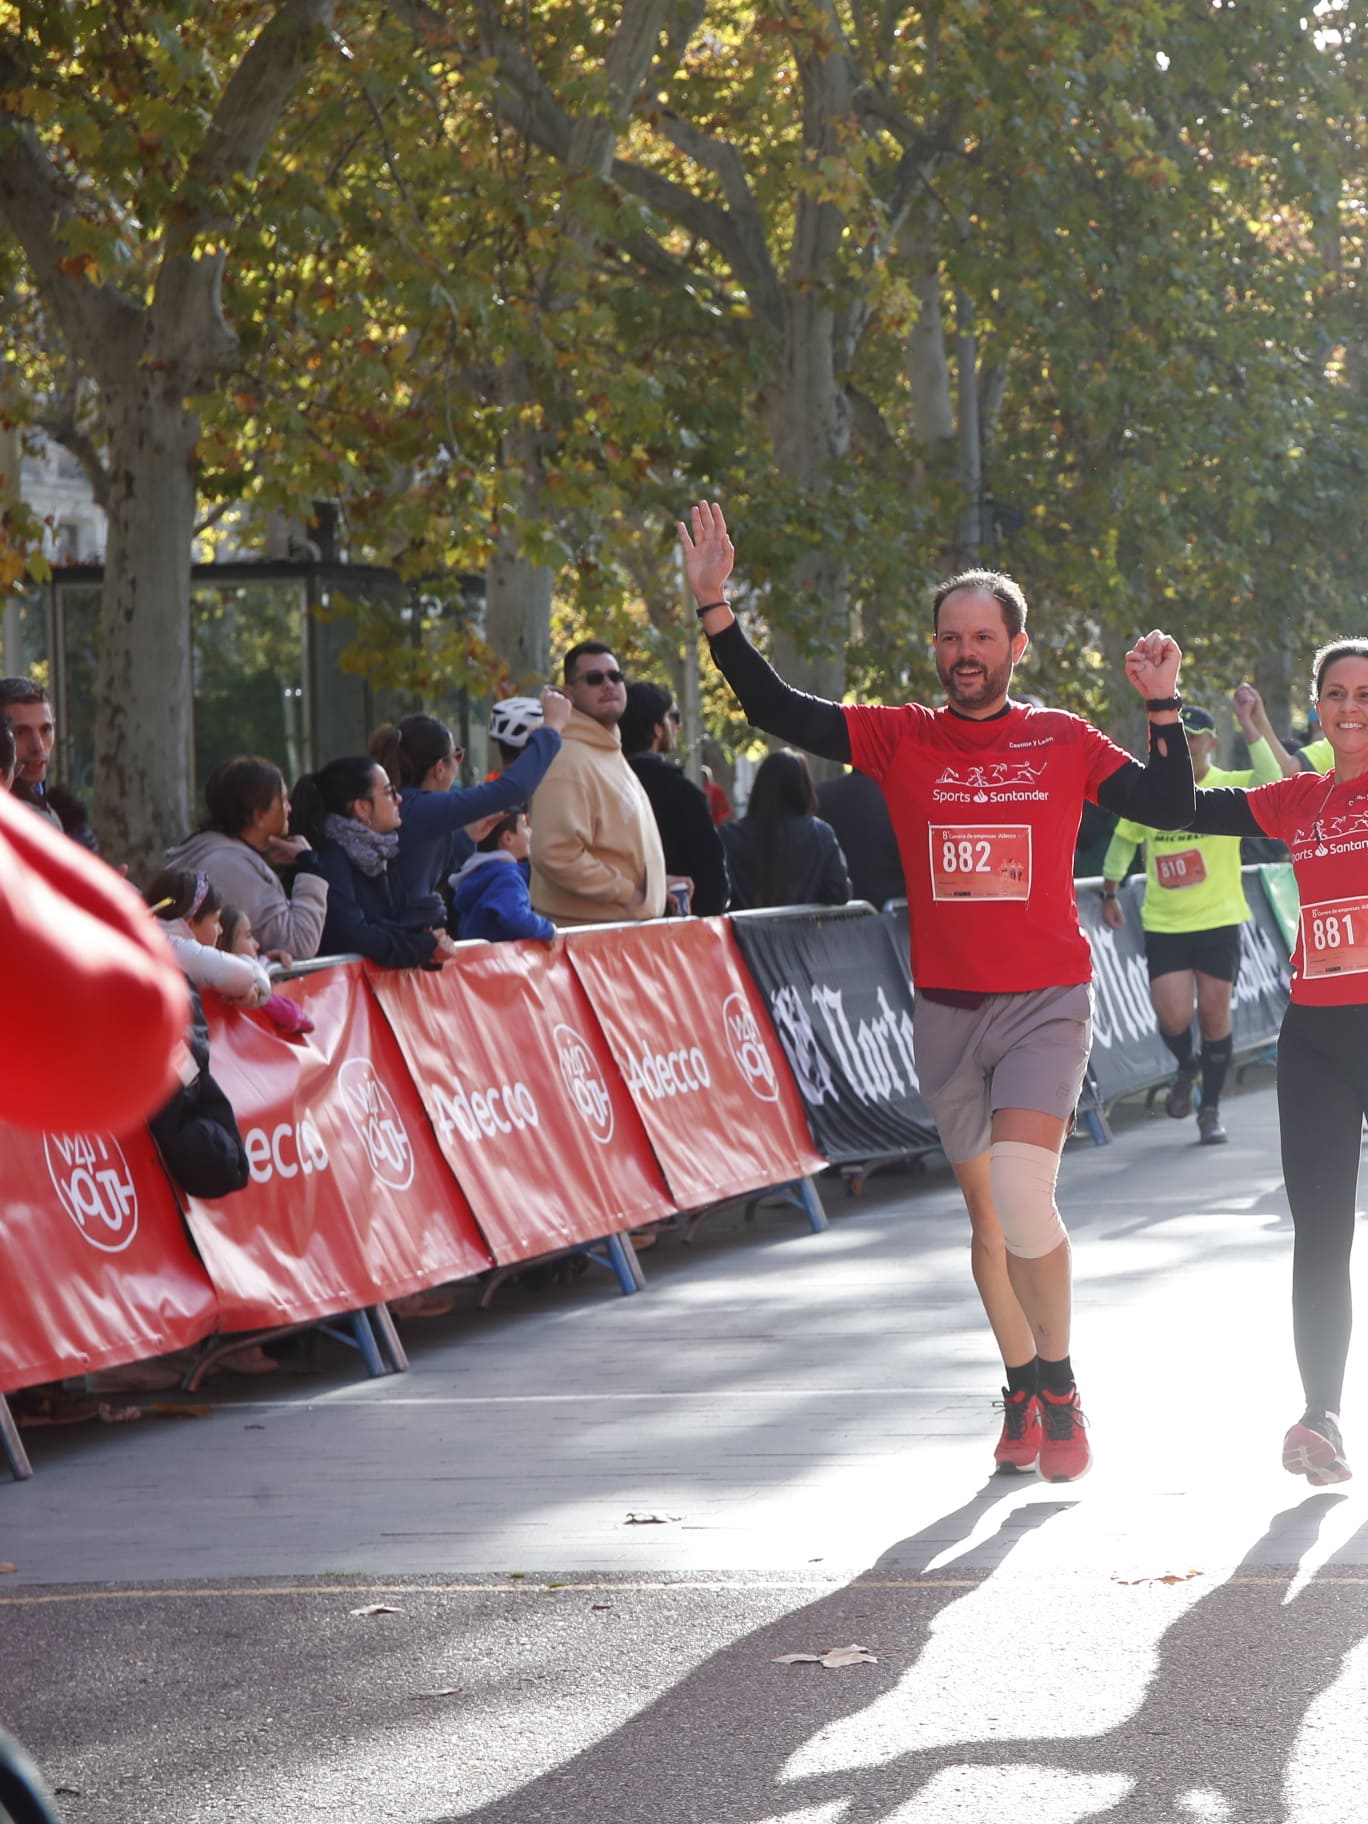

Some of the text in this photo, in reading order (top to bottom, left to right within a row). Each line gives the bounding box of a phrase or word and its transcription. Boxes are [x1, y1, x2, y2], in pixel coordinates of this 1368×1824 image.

[933, 789, 1049, 804] Sports Santander
[943, 841, 991, 873] 882
[1161, 858, 1187, 878] 810
[1313, 914, 1355, 950] 881
[627, 1039, 711, 1104] Adecco
[431, 1076, 539, 1146] Adecco
[244, 1119, 329, 1184] ecco
